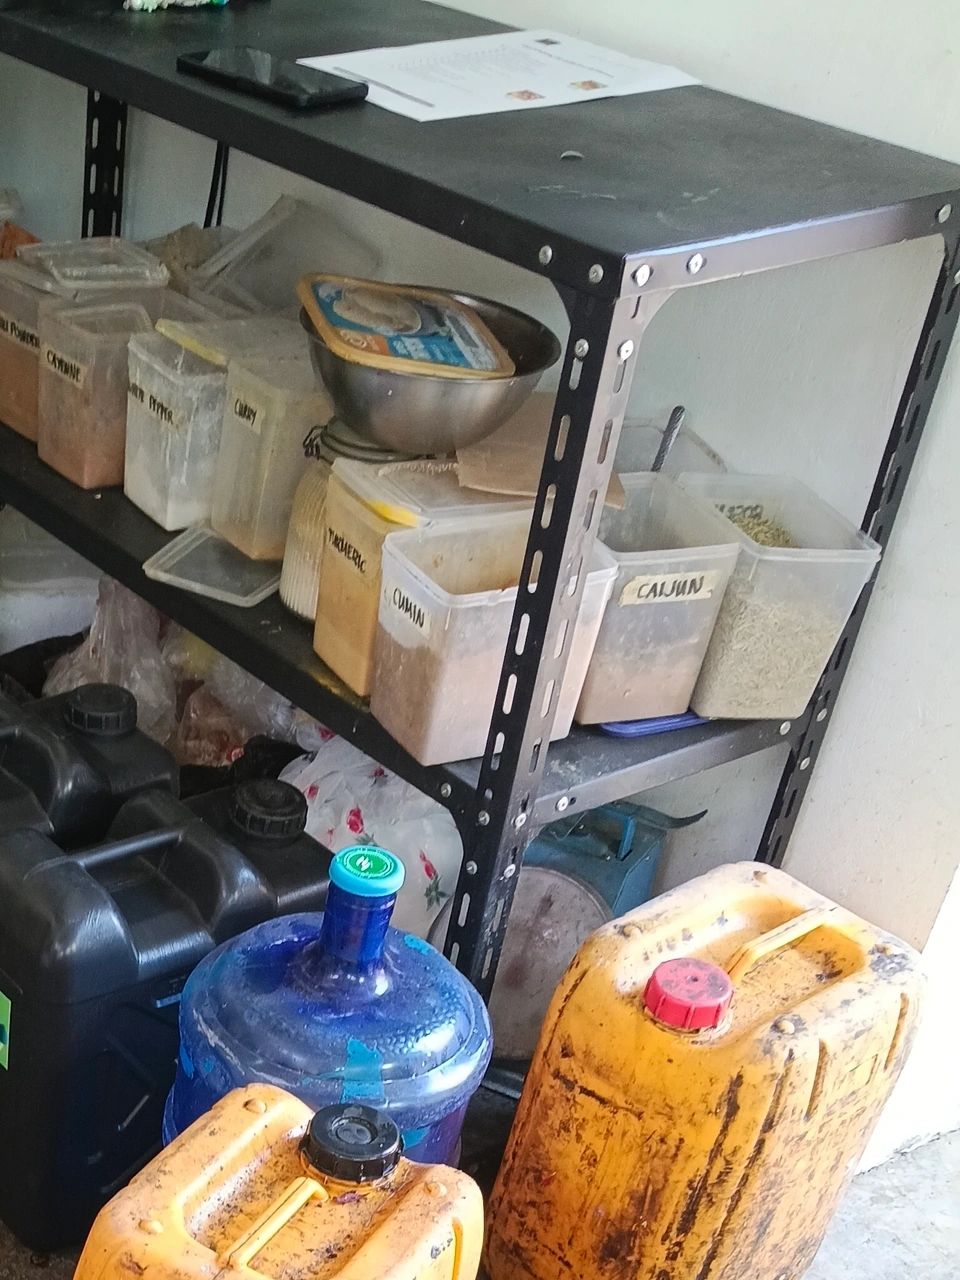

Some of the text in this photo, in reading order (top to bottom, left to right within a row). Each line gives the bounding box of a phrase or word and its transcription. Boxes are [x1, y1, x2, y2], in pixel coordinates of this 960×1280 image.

[234, 398, 257, 426] CURRY
[637, 575, 705, 600] CAIJUN
[393, 587, 425, 628] CUMIN
